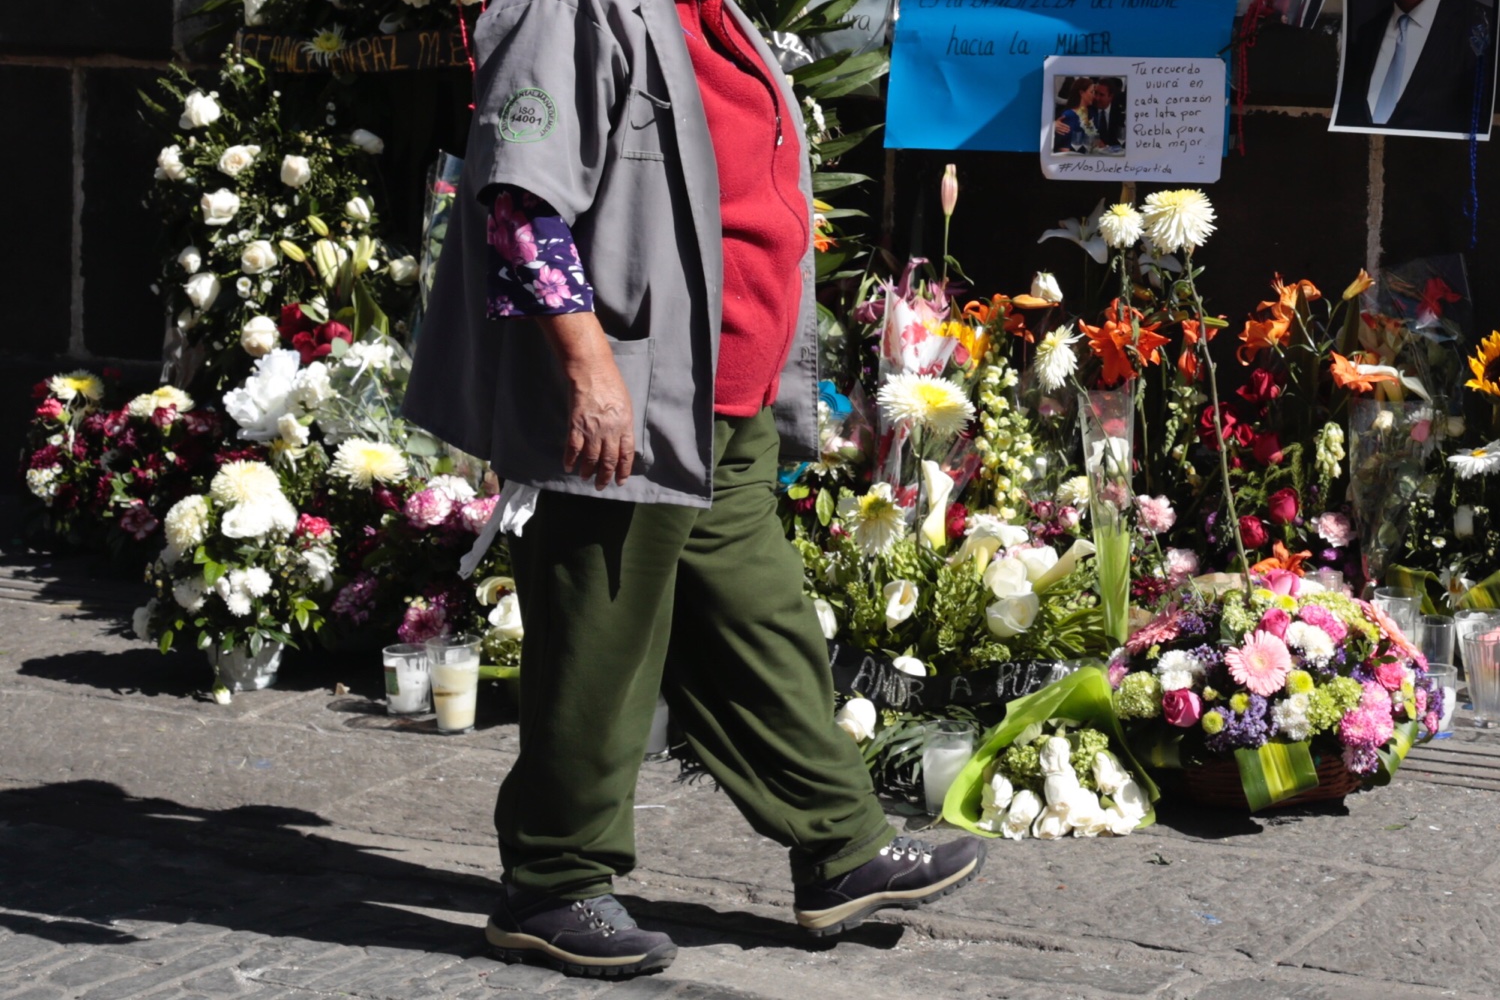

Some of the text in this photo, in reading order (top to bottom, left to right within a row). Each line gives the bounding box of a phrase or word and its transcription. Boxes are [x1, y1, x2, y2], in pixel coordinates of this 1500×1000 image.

[946, 25, 1114, 57] hacia la MUJER
[357, 33, 410, 73] PAZ
[1132, 62, 1201, 75] Tu recuerdo
[1146, 78, 1204, 89] vivirá en
[1134, 94, 1212, 106] cada corazón
[519, 106, 535, 116] ISO
[1134, 106, 1201, 122] que lata por
[511, 113, 542, 126] 14001
[1133, 123, 1205, 139] Puebla para
[1135, 138, 1161, 149] verla
[850, 655, 925, 710] AMOR
[949, 675, 973, 701] A
